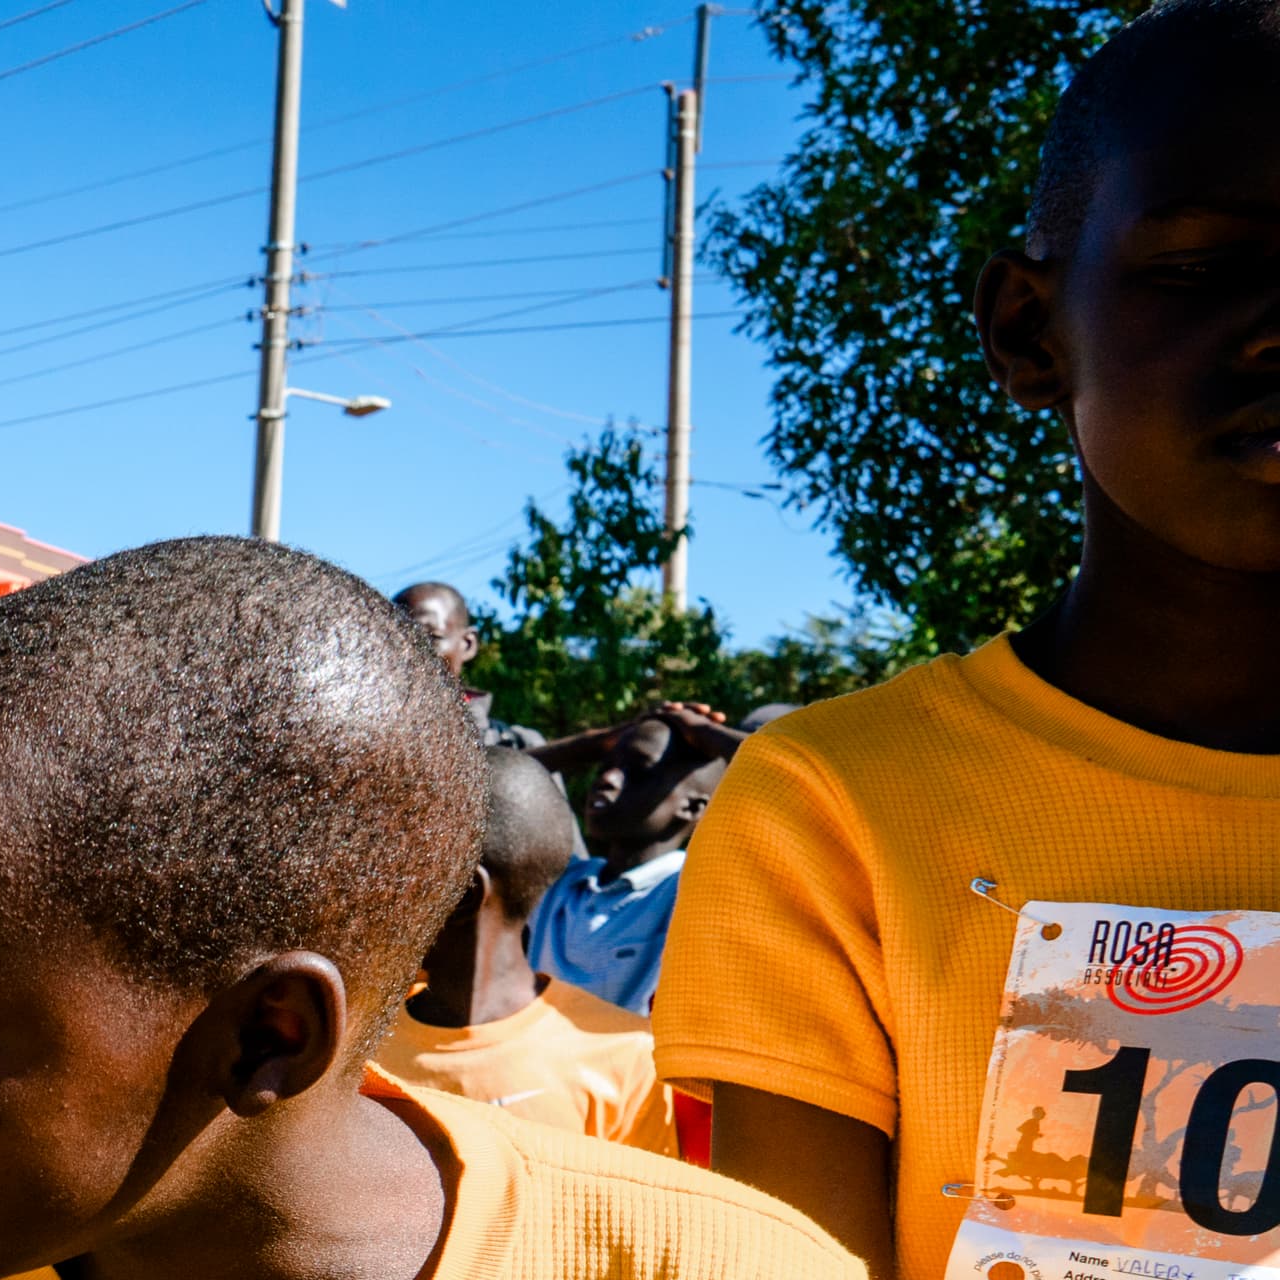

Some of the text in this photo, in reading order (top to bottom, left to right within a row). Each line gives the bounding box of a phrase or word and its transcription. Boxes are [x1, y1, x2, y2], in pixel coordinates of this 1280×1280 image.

[1088, 920, 1175, 967] ROSA
[1083, 968, 1168, 989] ASSOCIATI
[1069, 1251, 1109, 1268] Name
